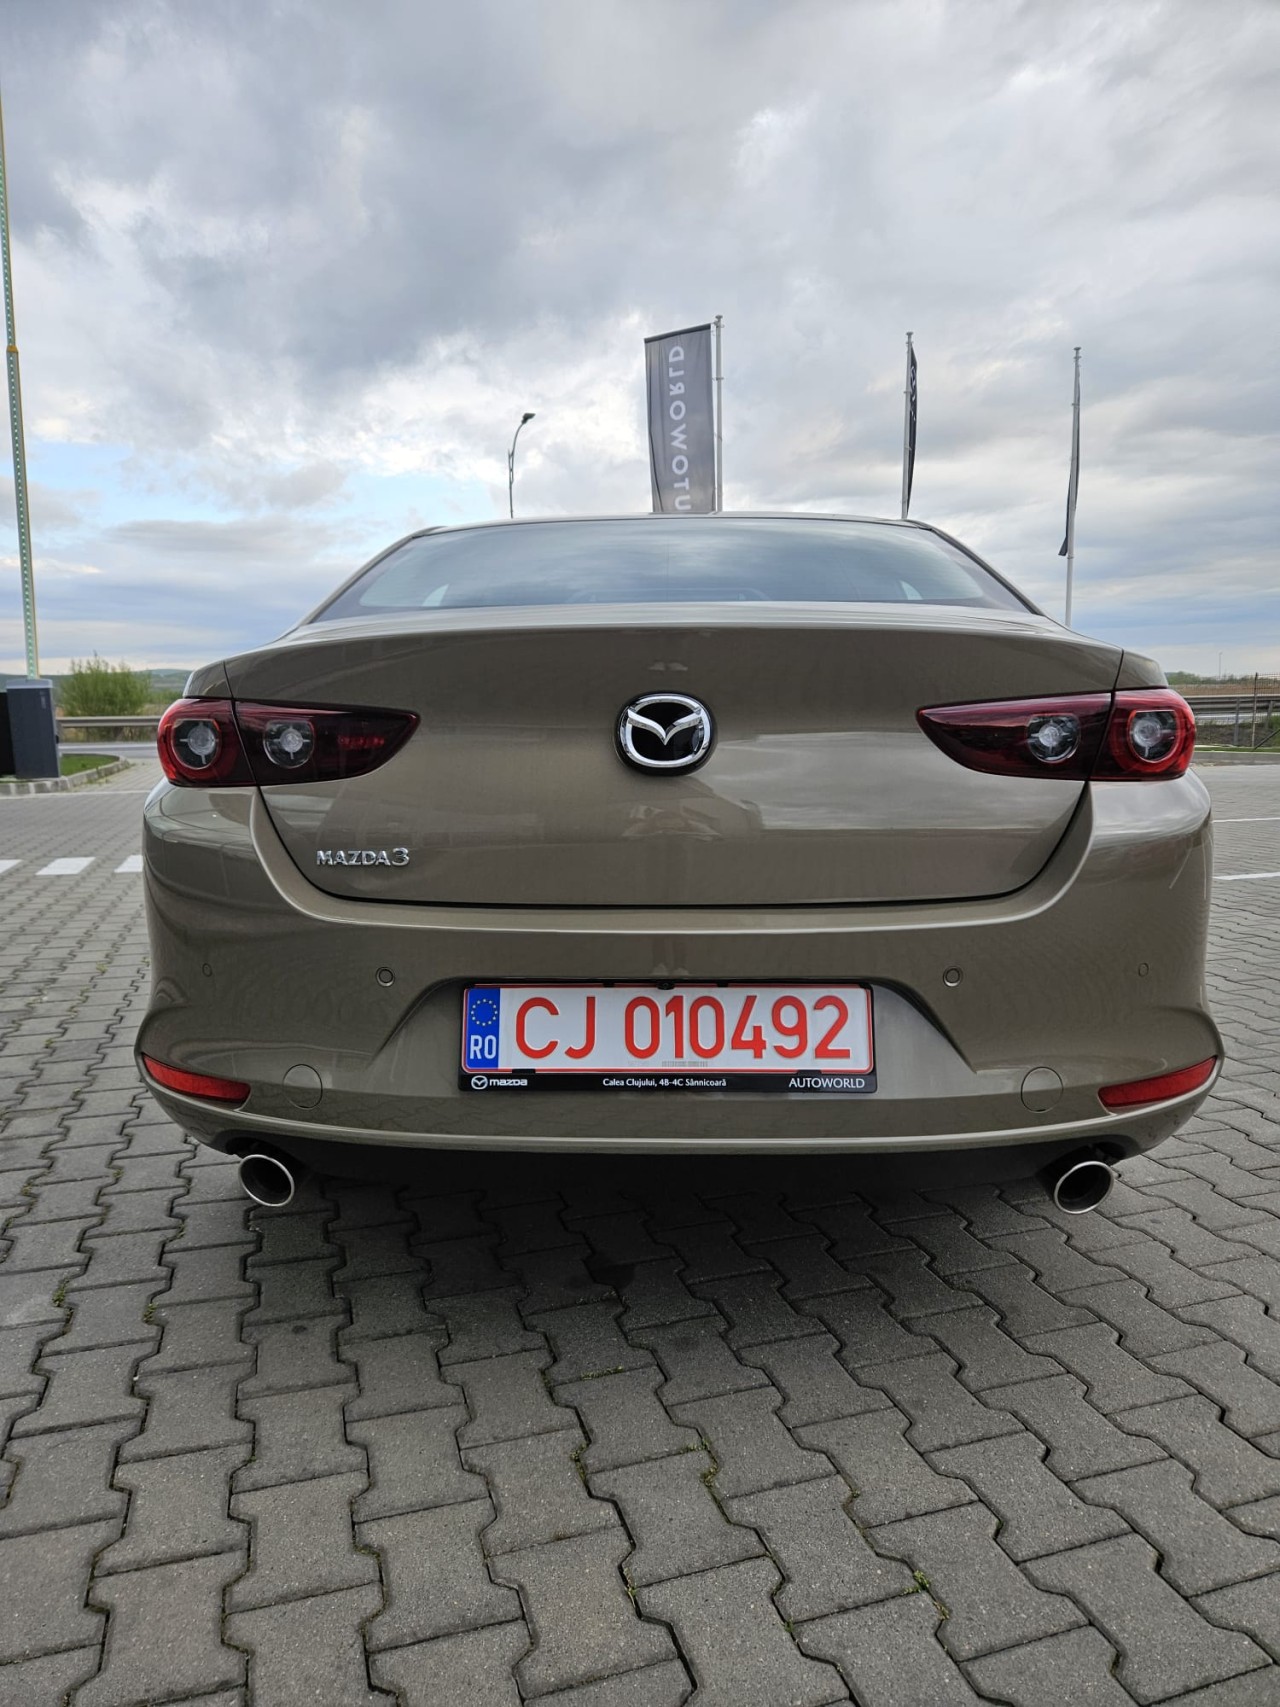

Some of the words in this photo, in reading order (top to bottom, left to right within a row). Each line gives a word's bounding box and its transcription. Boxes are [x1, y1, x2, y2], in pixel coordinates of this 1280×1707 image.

[515, 996, 596, 1060] CJ
[624, 995, 852, 1060] 010492
[469, 1034, 497, 1060] RO
[489, 1078, 528, 1087] mazda
[602, 1078, 625, 1087] Calea
[626, 1078, 658, 1088] Clujului,
[659, 1078, 684, 1087] 4B-4C
[685, 1078, 727, 1087] Sânnicoară
[788, 1077, 865, 1089] AUTOWORLD
